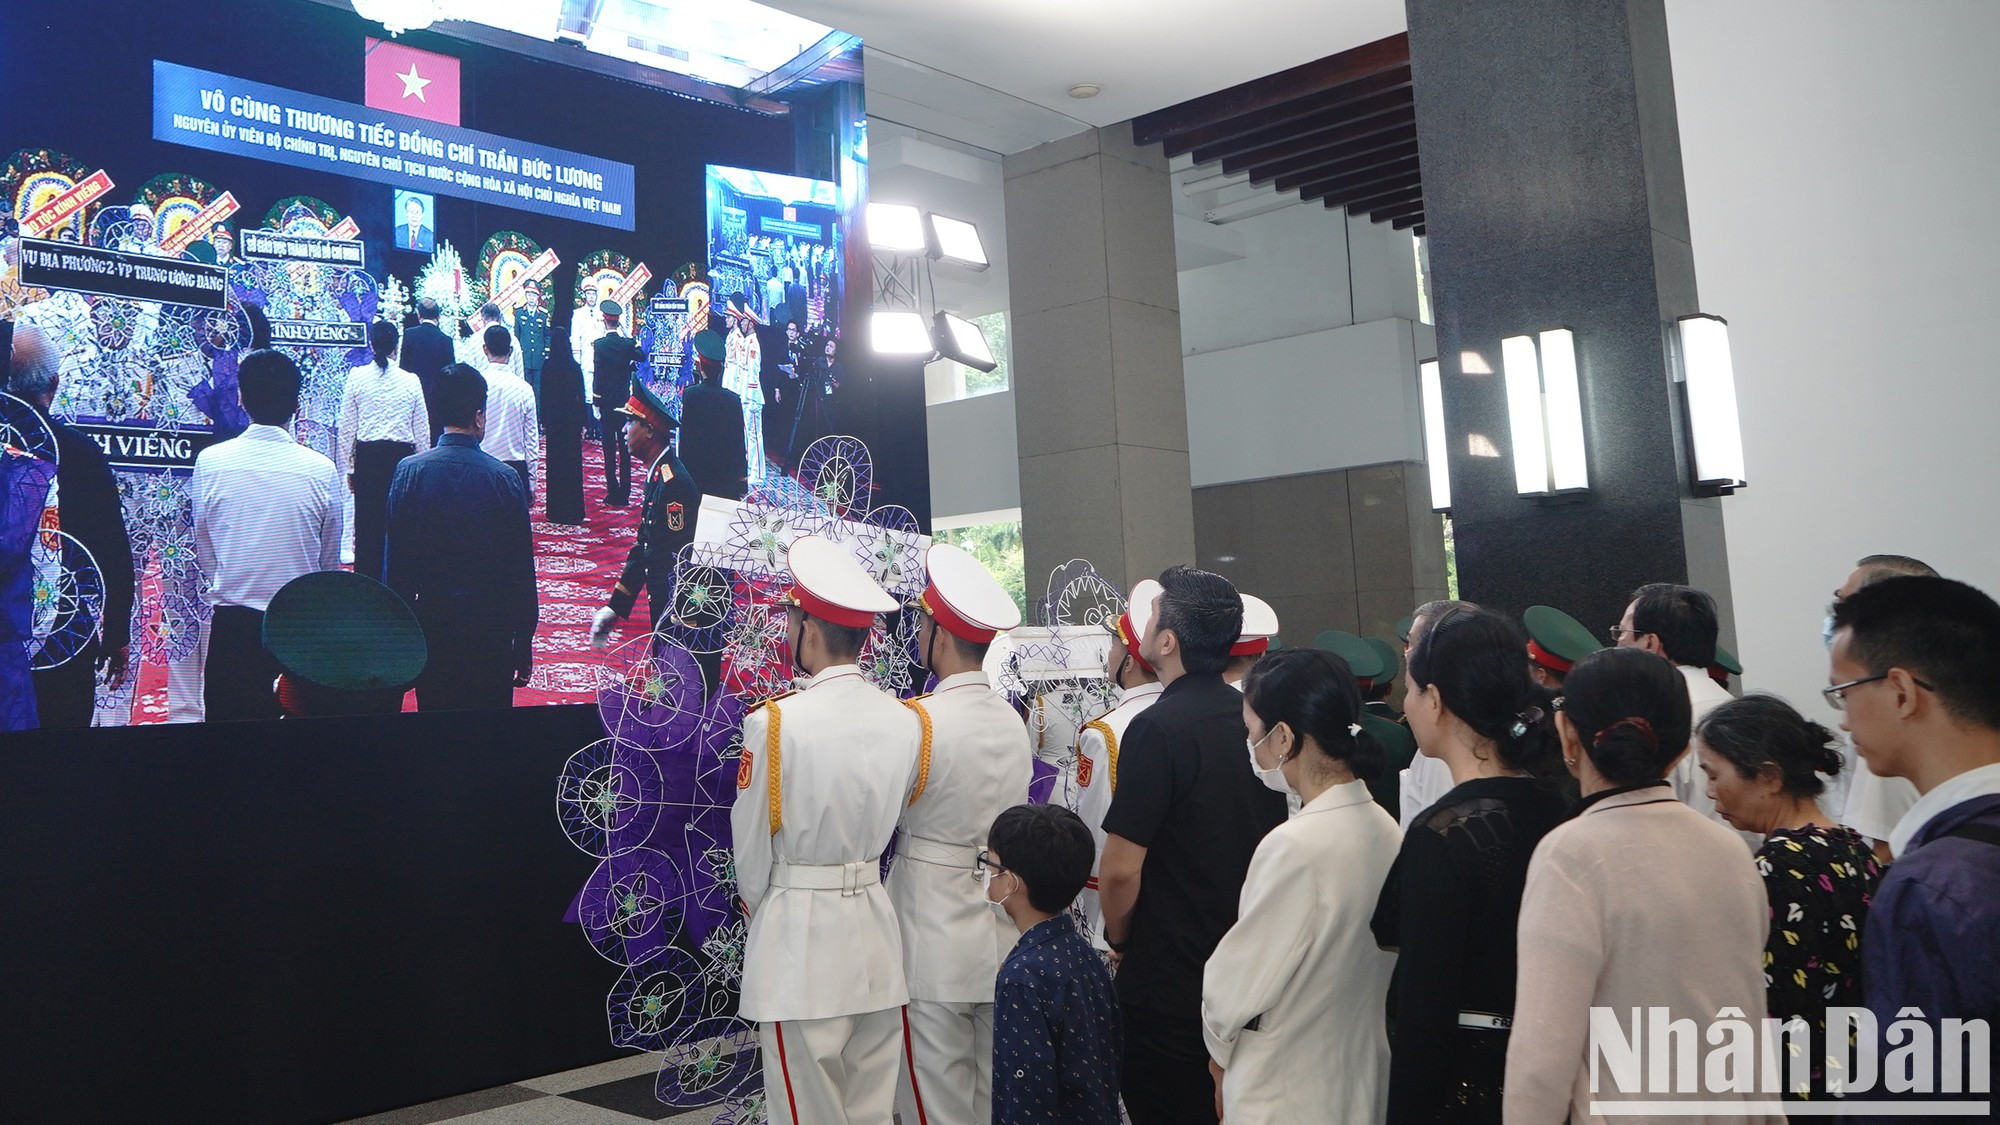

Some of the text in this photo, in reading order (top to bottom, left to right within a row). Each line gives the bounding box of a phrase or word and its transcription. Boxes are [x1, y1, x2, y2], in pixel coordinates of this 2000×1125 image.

[200, 88, 603, 192] VÔ CÙNG THƯƠNG TIẾC ĐỒNG CHÍ TRẦN ĐỨC LƯƠNG
[173, 114, 622, 216] NGUYÊN ỦY VIÊN BỘ CHÍNH TRỊ, NGUYÊN CHỦ TỊCH NƯỚC CỘNG HÒA XÃ HỘI CHỦ NGHĨA VIỆT NAM
[53, 196, 78, 216] KÍNH
[74, 180, 102, 202] VIẾNG
[22, 248, 38, 269] VỤ
[40, 251, 60, 271] ĐỊA
[61, 255, 106, 273] PHƯƠNG
[134, 264, 167, 283] TRUNG
[168, 269, 195, 288] ƯƠNG
[196, 271, 224, 291] ĐẢNG
[302, 323, 349, 341] VIẾNG
[115, 432, 192, 459] VIẾNG
